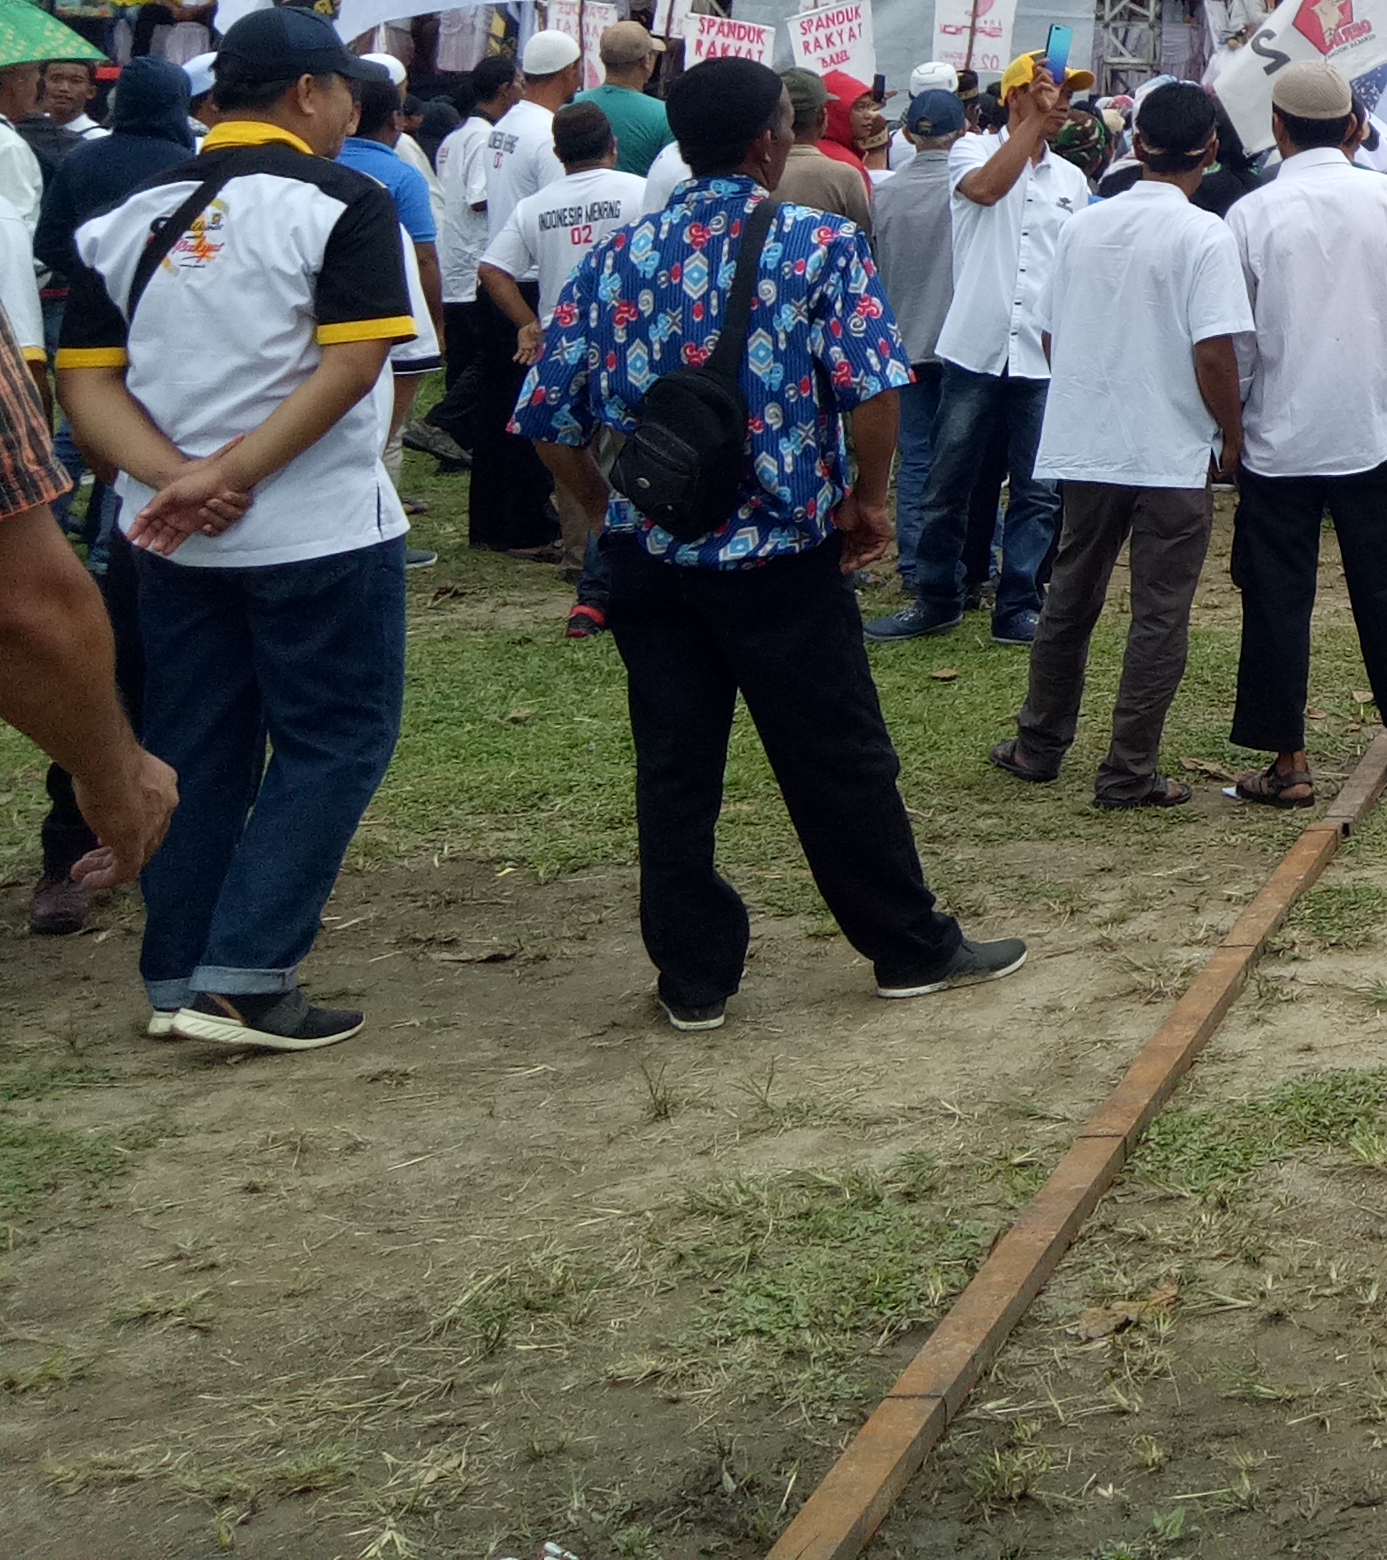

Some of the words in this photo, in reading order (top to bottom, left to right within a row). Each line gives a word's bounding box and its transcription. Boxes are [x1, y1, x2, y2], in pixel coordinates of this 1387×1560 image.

[699, 14, 766, 46] SPANDUK
[800, 3, 862, 36] SPANDUK
[695, 38, 763, 60] RAKYAT
[802, 22, 862, 56] RAKYAT
[538, 207, 583, 232] INDONESIA
[570, 224, 594, 246] 02
